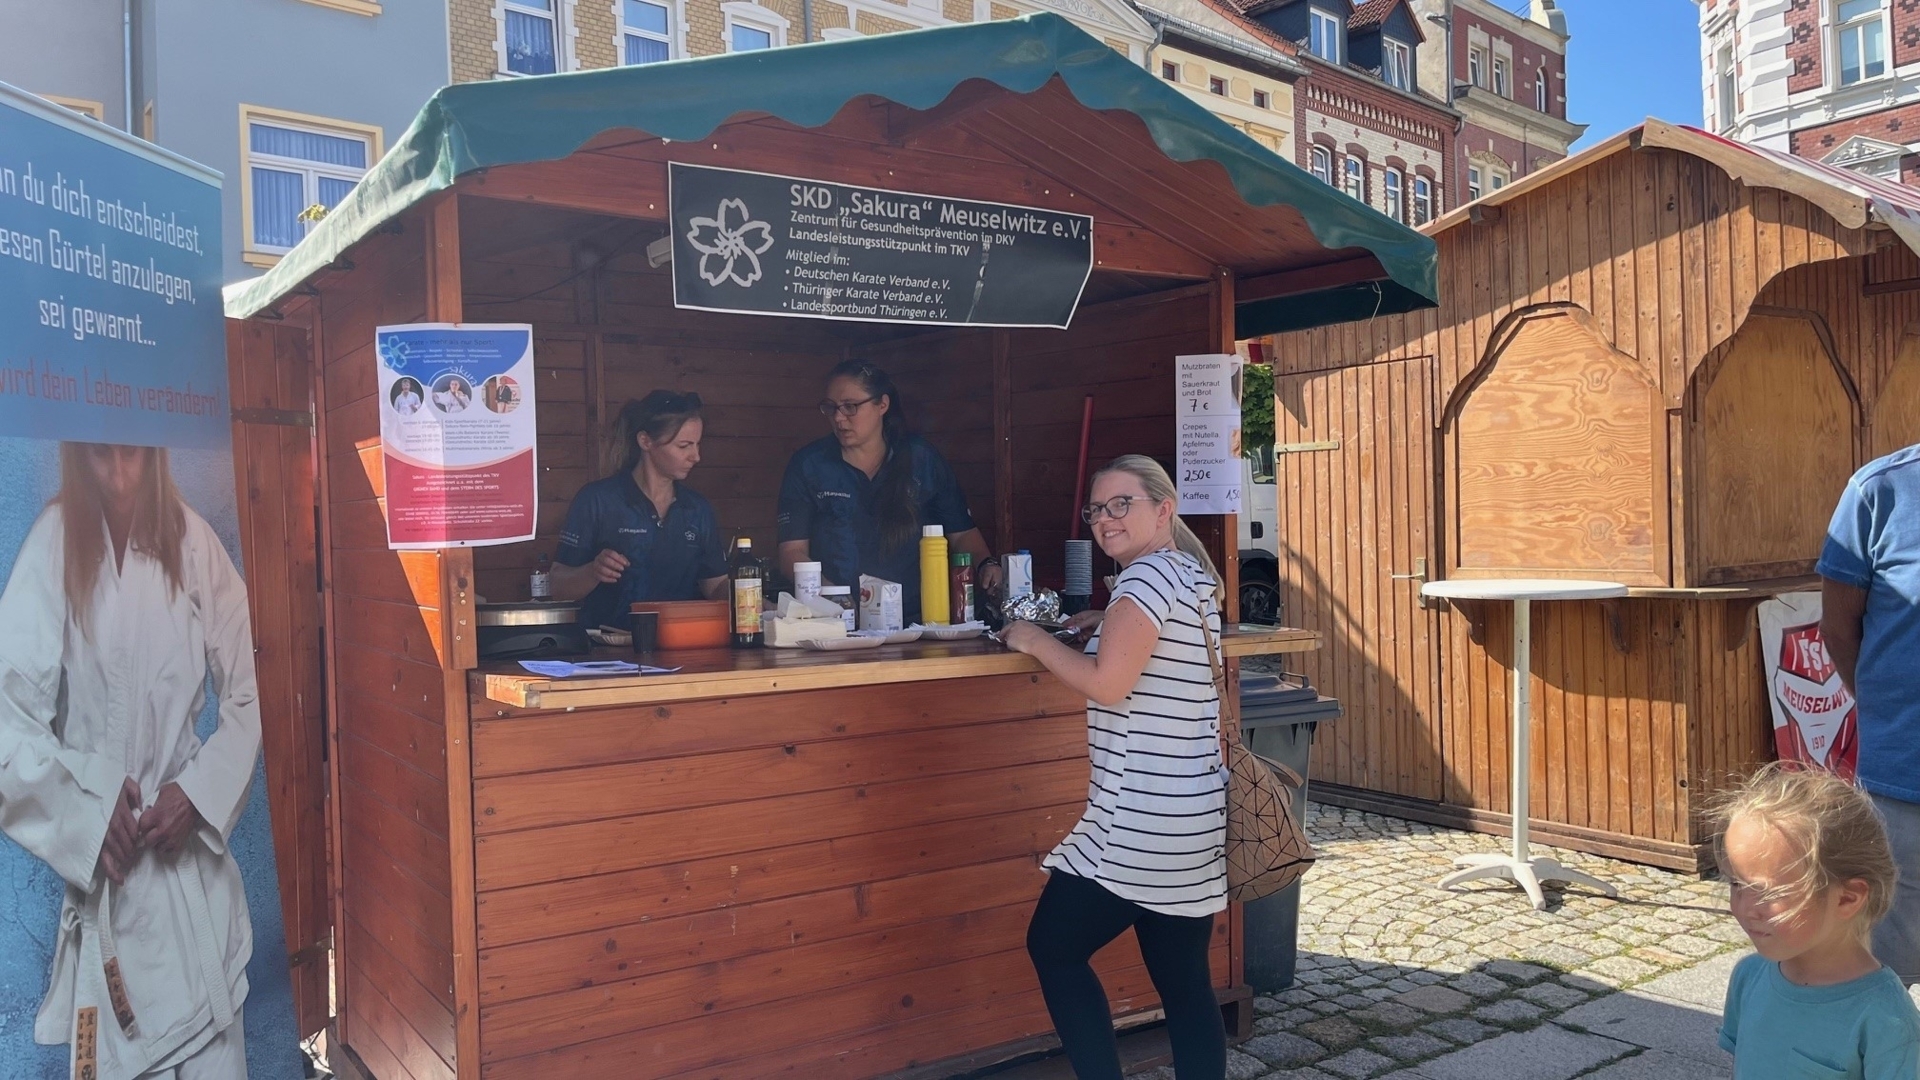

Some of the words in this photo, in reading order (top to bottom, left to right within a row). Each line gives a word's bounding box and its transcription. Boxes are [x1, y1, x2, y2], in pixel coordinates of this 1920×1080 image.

[23, 161, 45, 206] du
[51, 171, 91, 220] dich
[97, 198, 203, 257] entscheidest,
[790, 183, 832, 210] SKD
[940, 203, 1047, 235] Meuselwitz
[1052, 219, 1086, 241] e.V.
[790, 210, 838, 227] Zentrum
[841, 216, 858, 229] für
[860, 219, 978, 242] Gesundheitsprävention
[995, 234, 1016, 246] DKV
[789, 227, 932, 253] Landesleistungsstützpunkt
[934, 243, 947, 254] im
[950, 244, 970, 257] TKV
[49, 228, 107, 281] Gürtel
[112, 257, 196, 305] anzulegen,
[785, 249, 831, 265] Mitglied
[833, 254, 850, 266] im:
[794, 266, 849, 282] Deutschen
[852, 272, 887, 285] Karate
[889, 275, 930, 288] Verband
[931, 279, 951, 290] e.V.
[792, 282, 844, 299] Thüringer
[846, 287, 880, 300] Karate
[882, 290, 922, 303] Verband
[925, 294, 944, 305] e.V.
[790, 298, 878, 316] Landessportbund
[880, 304, 927, 320] Thüringen
[929, 308, 948, 320] e.V.
[39, 295, 66, 330] sei
[72, 307, 156, 346] gewarnt...
[1182, 363, 1221, 371] Mutzbraten
[42, 359, 78, 403] dein
[84, 365, 132, 409] Leben
[1182, 380, 1221, 388] Sauerkraut
[1182, 389, 1195, 397] und
[1189, 399, 1198, 412] 7
[1203, 402, 1209, 411] €
[1182, 423, 1207, 431] Crepes
[1182, 441, 1215, 449] Apfelmus
[1182, 492, 1210, 500] Kaffee
